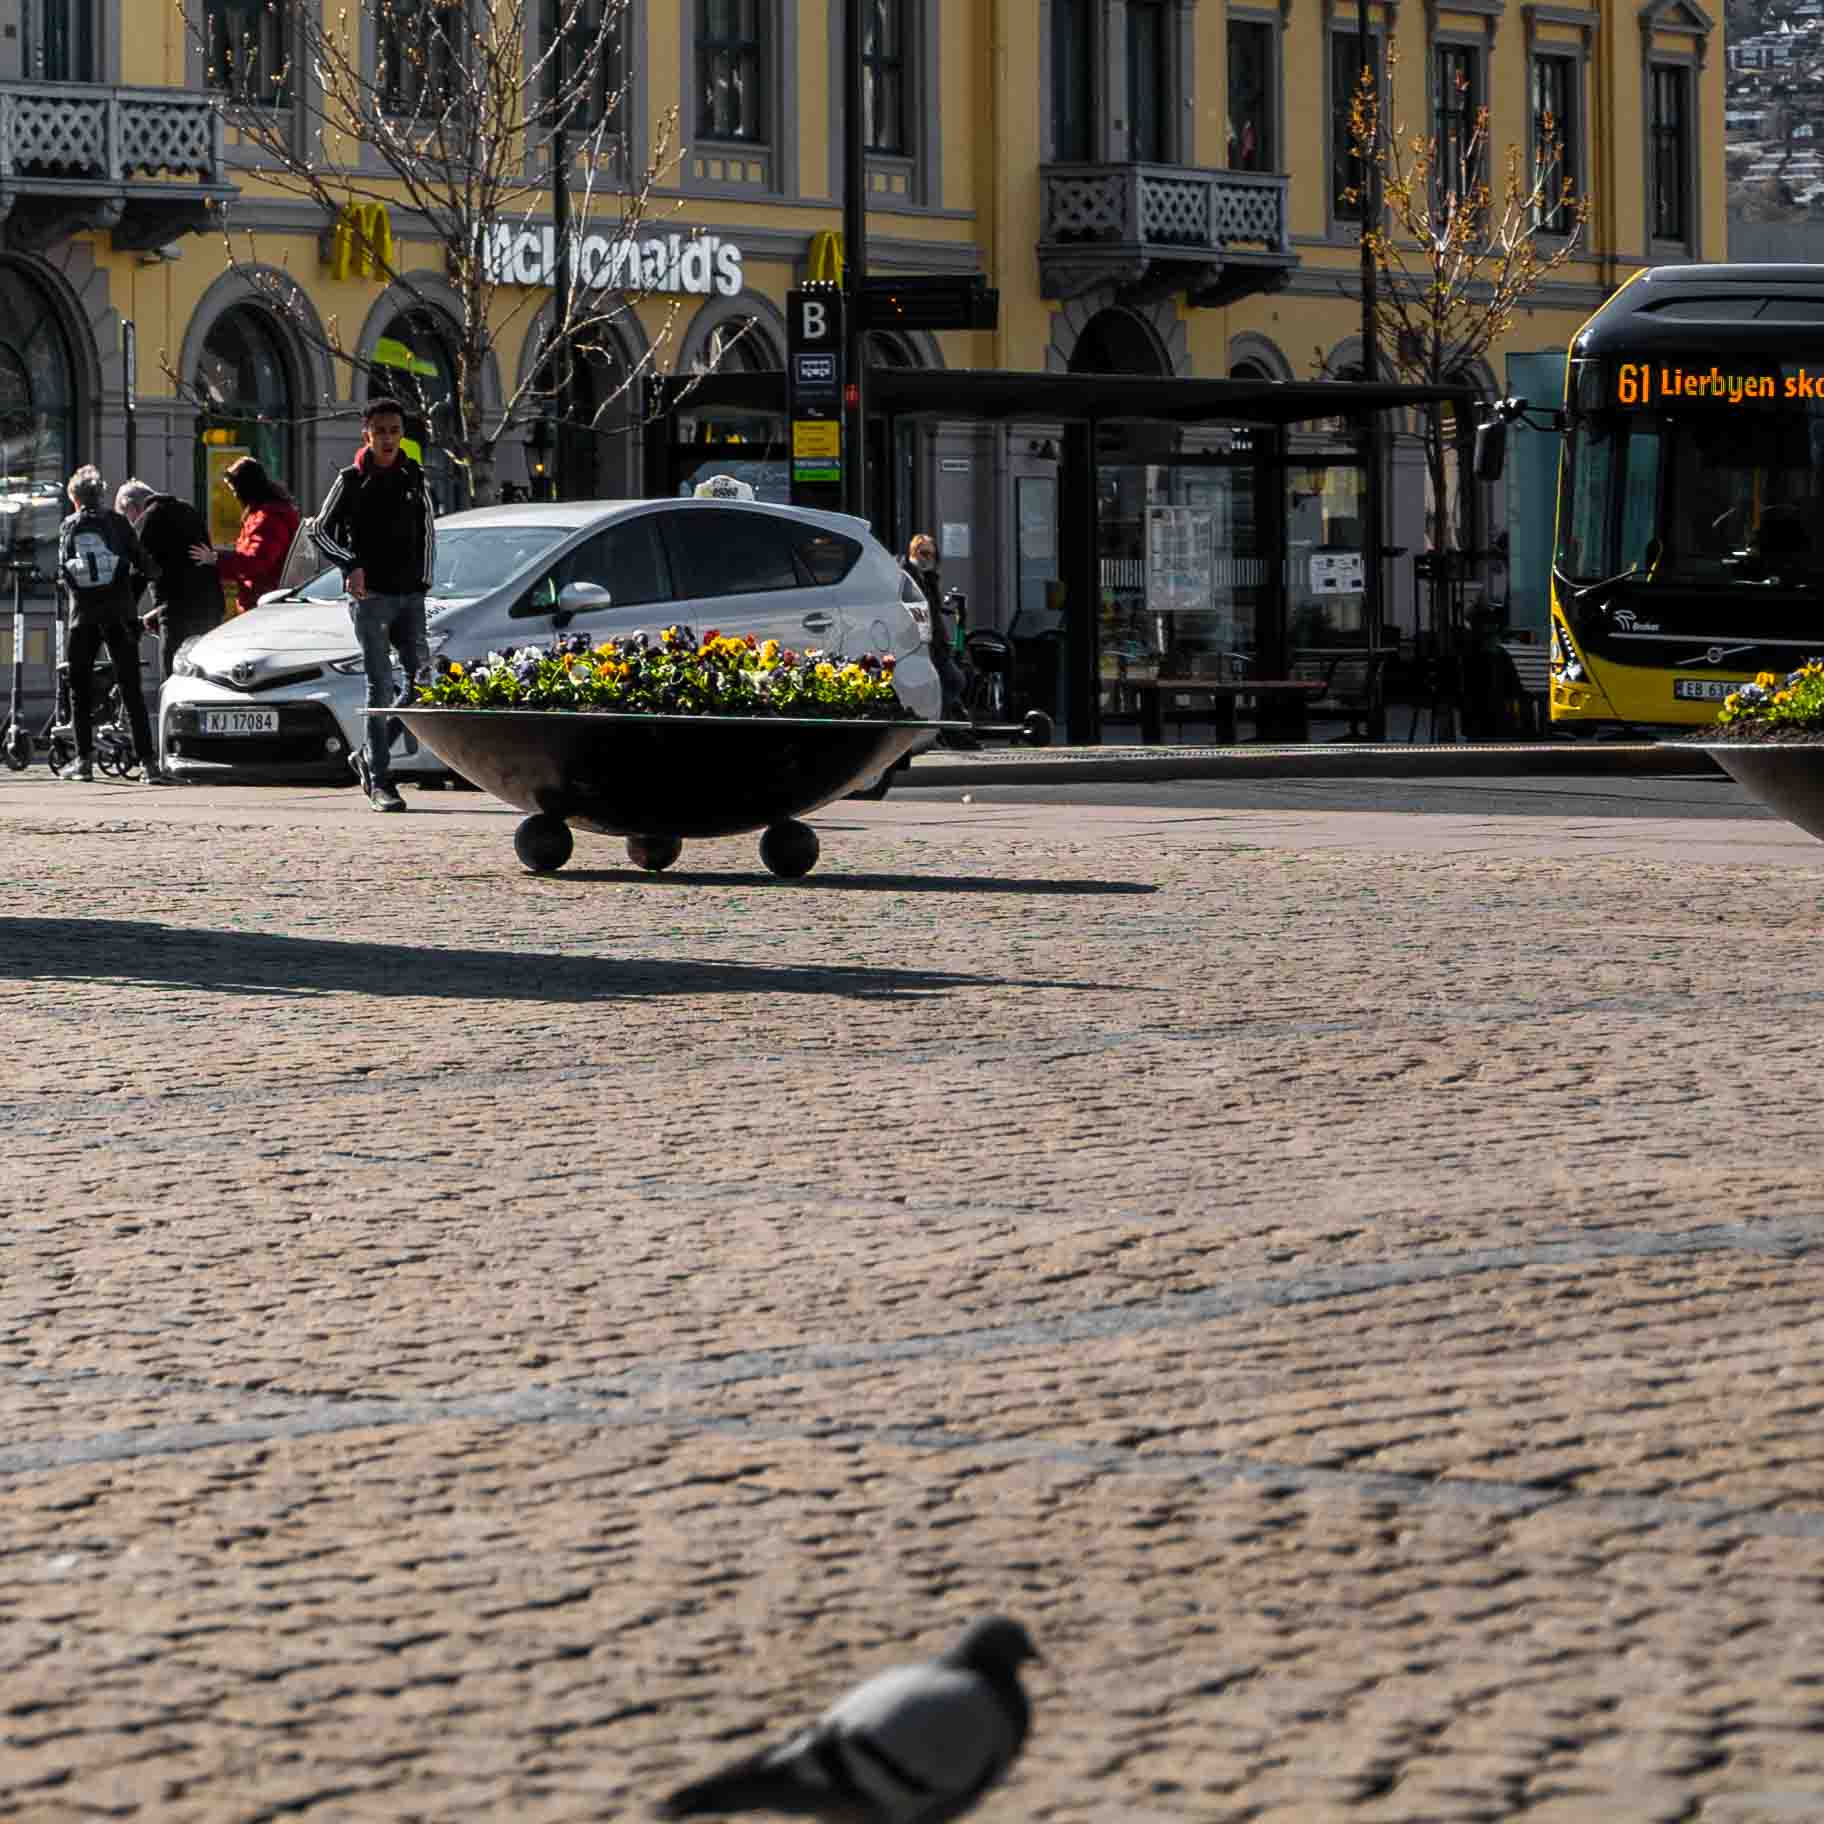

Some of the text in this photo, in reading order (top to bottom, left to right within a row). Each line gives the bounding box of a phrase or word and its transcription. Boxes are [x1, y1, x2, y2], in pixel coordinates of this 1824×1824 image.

[802, 301, 827, 339] B
[1618, 363, 1650, 404] 61
[1661, 367, 1775, 404] Lierbyen
